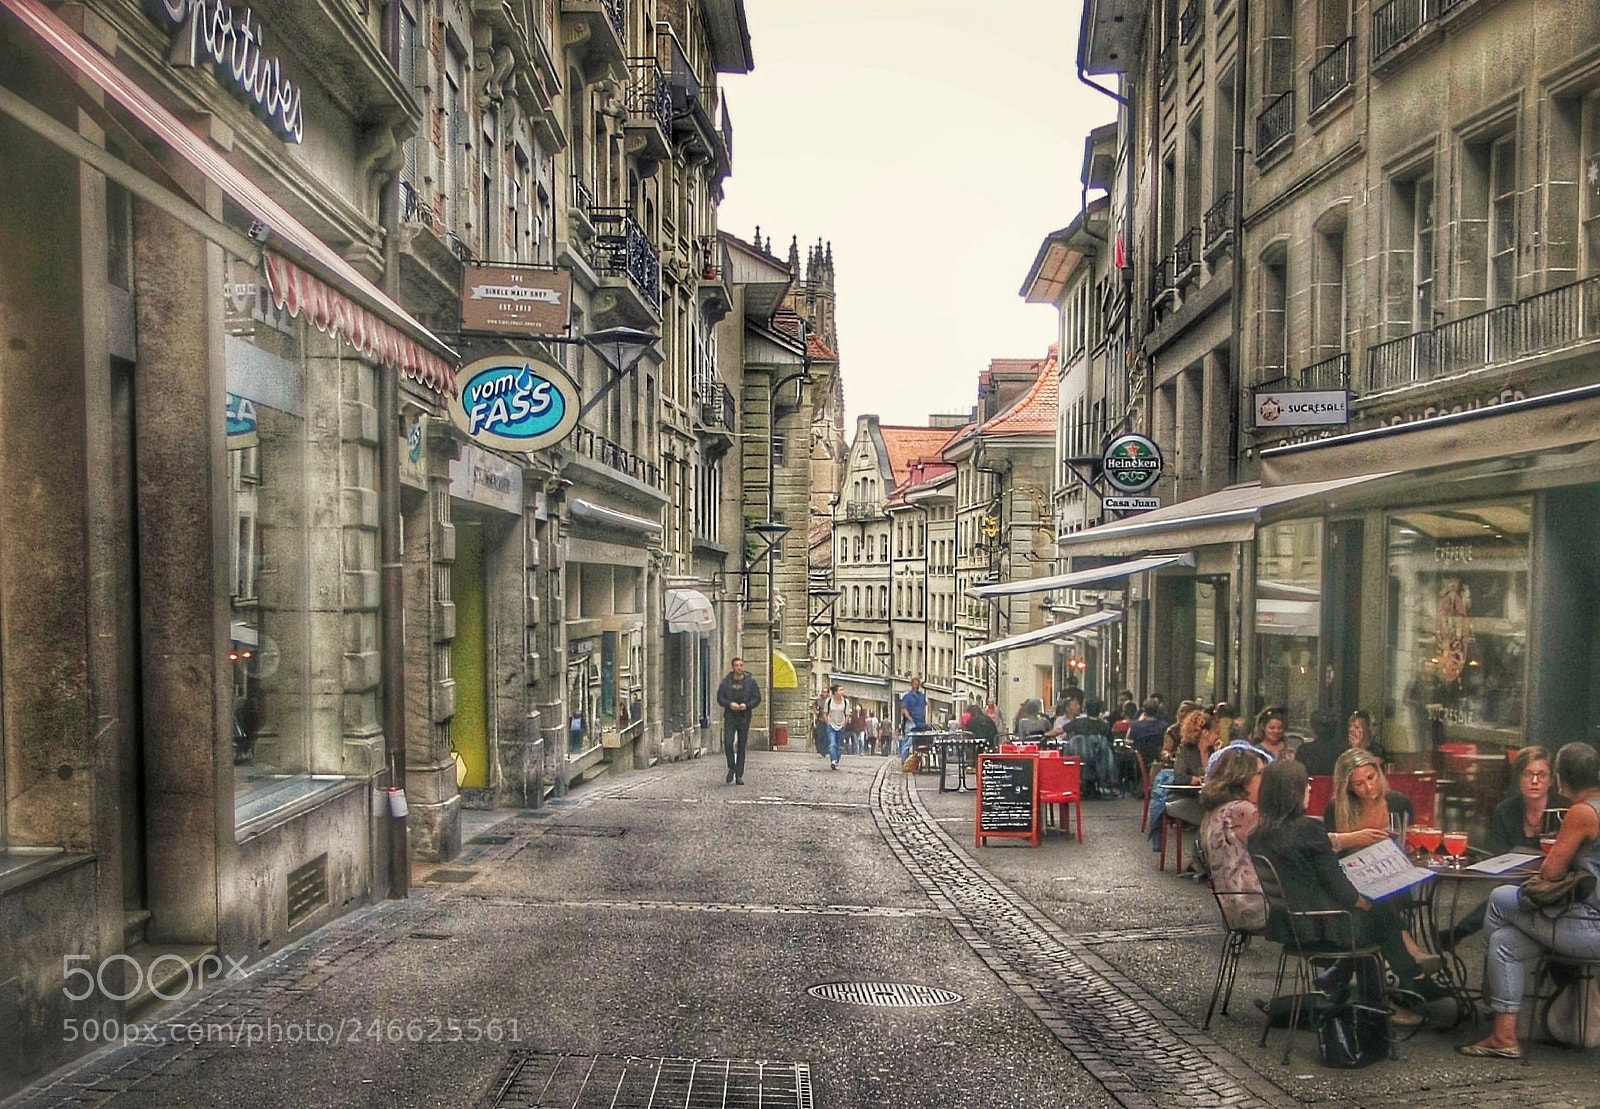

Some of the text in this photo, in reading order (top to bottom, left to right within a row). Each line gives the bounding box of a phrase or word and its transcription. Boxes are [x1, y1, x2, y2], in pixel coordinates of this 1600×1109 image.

[485, 288, 547, 299] SINGLE MALT SHOP
[515, 304, 532, 312] 2010
[471, 374, 514, 402] vom
[469, 381, 551, 434] FASS
[1107, 458, 1157, 468] Heineken
[1105, 499, 1157, 508] Casa Juan
